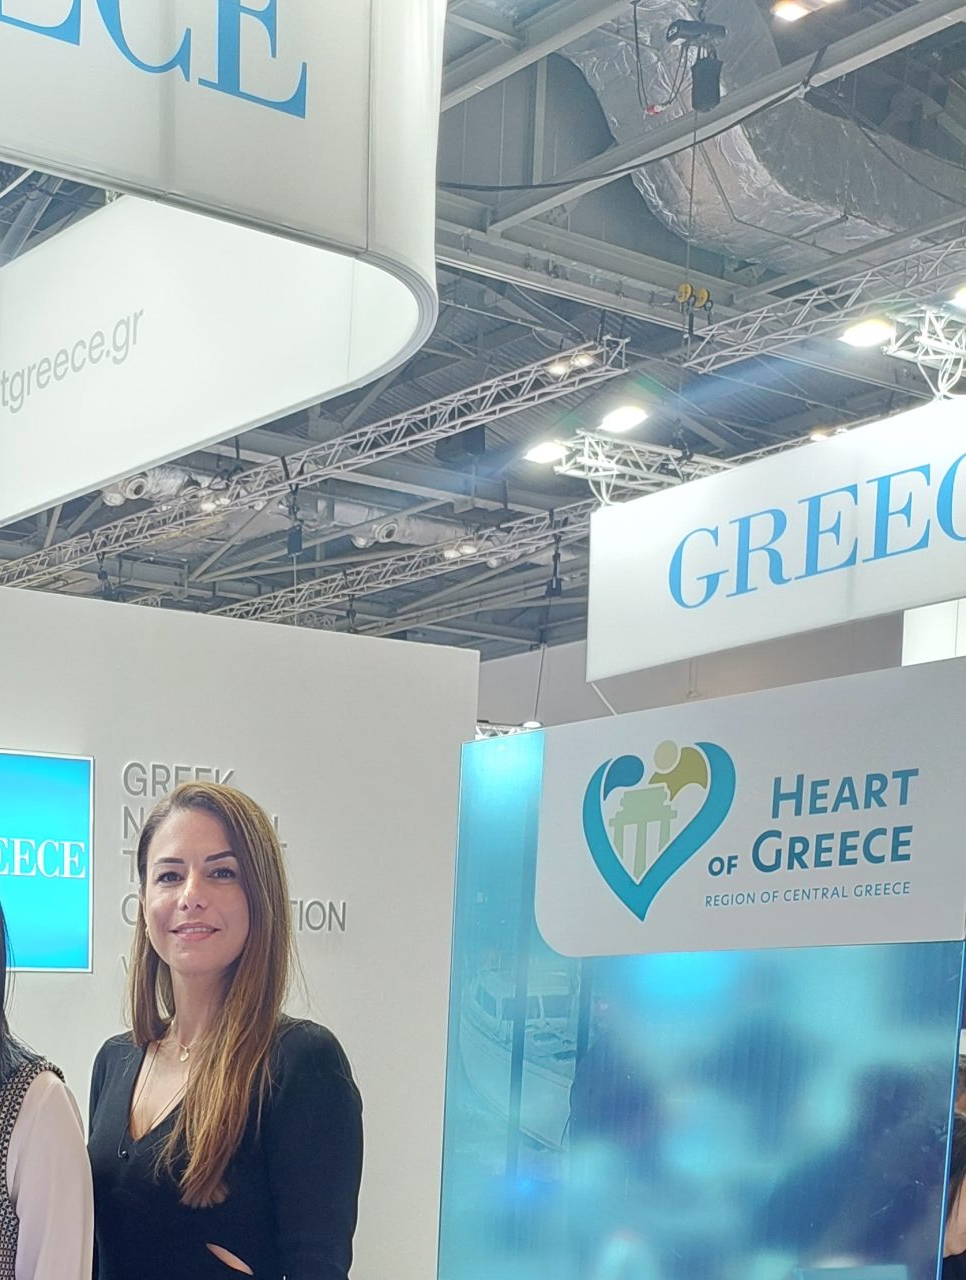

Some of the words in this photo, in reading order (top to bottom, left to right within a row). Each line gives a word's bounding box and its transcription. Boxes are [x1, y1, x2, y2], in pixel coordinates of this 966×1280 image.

[771, 768, 919, 820] HEART
[708, 855, 738, 877] OF
[752, 825, 913, 873] GREECE
[705, 891, 755, 907] REGION
[760, 890, 779, 905] OF
[784, 885, 848, 902] CENTRAL
[853, 881, 910, 898] GREECE
